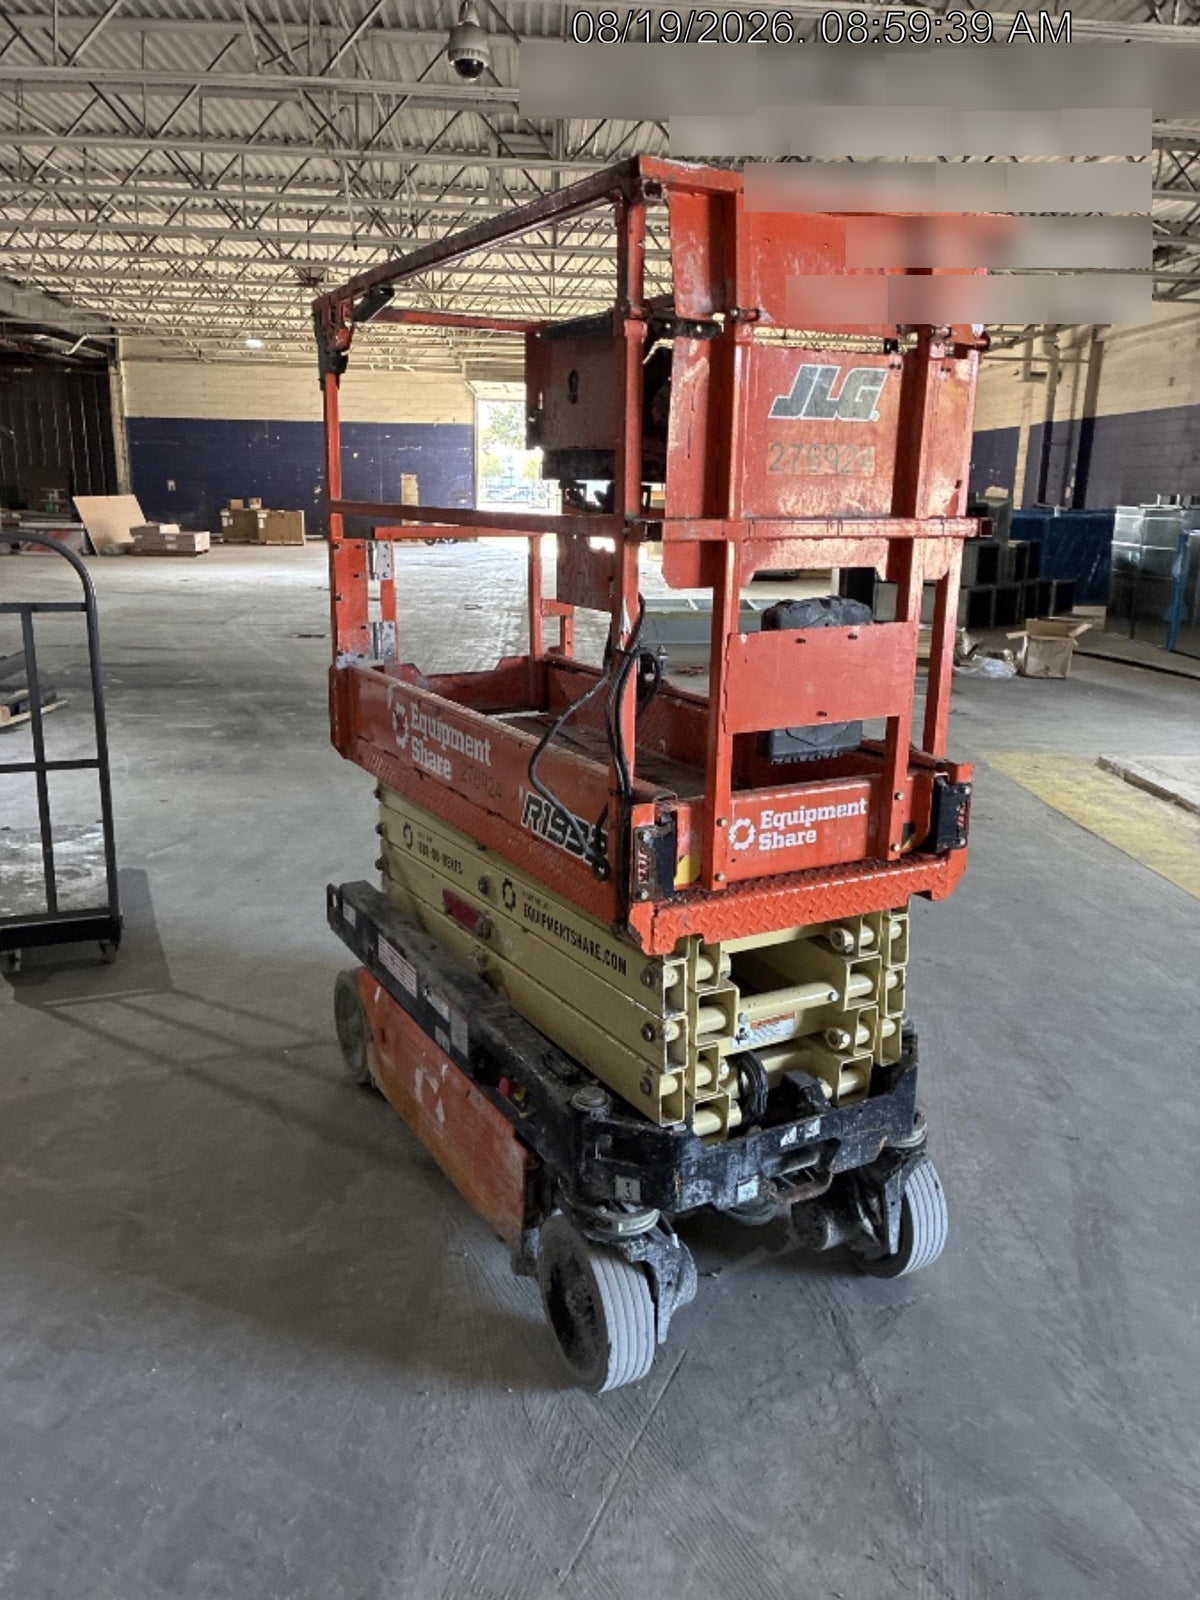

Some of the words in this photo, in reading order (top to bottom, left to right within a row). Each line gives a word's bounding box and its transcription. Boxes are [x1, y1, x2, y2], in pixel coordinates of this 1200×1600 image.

[768, 364, 888, 421] JLG
[410, 702, 492, 766] Equipment
[411, 738, 452, 781] Share
[760, 798, 867, 830] Equipment
[758, 829, 817, 851] Share
